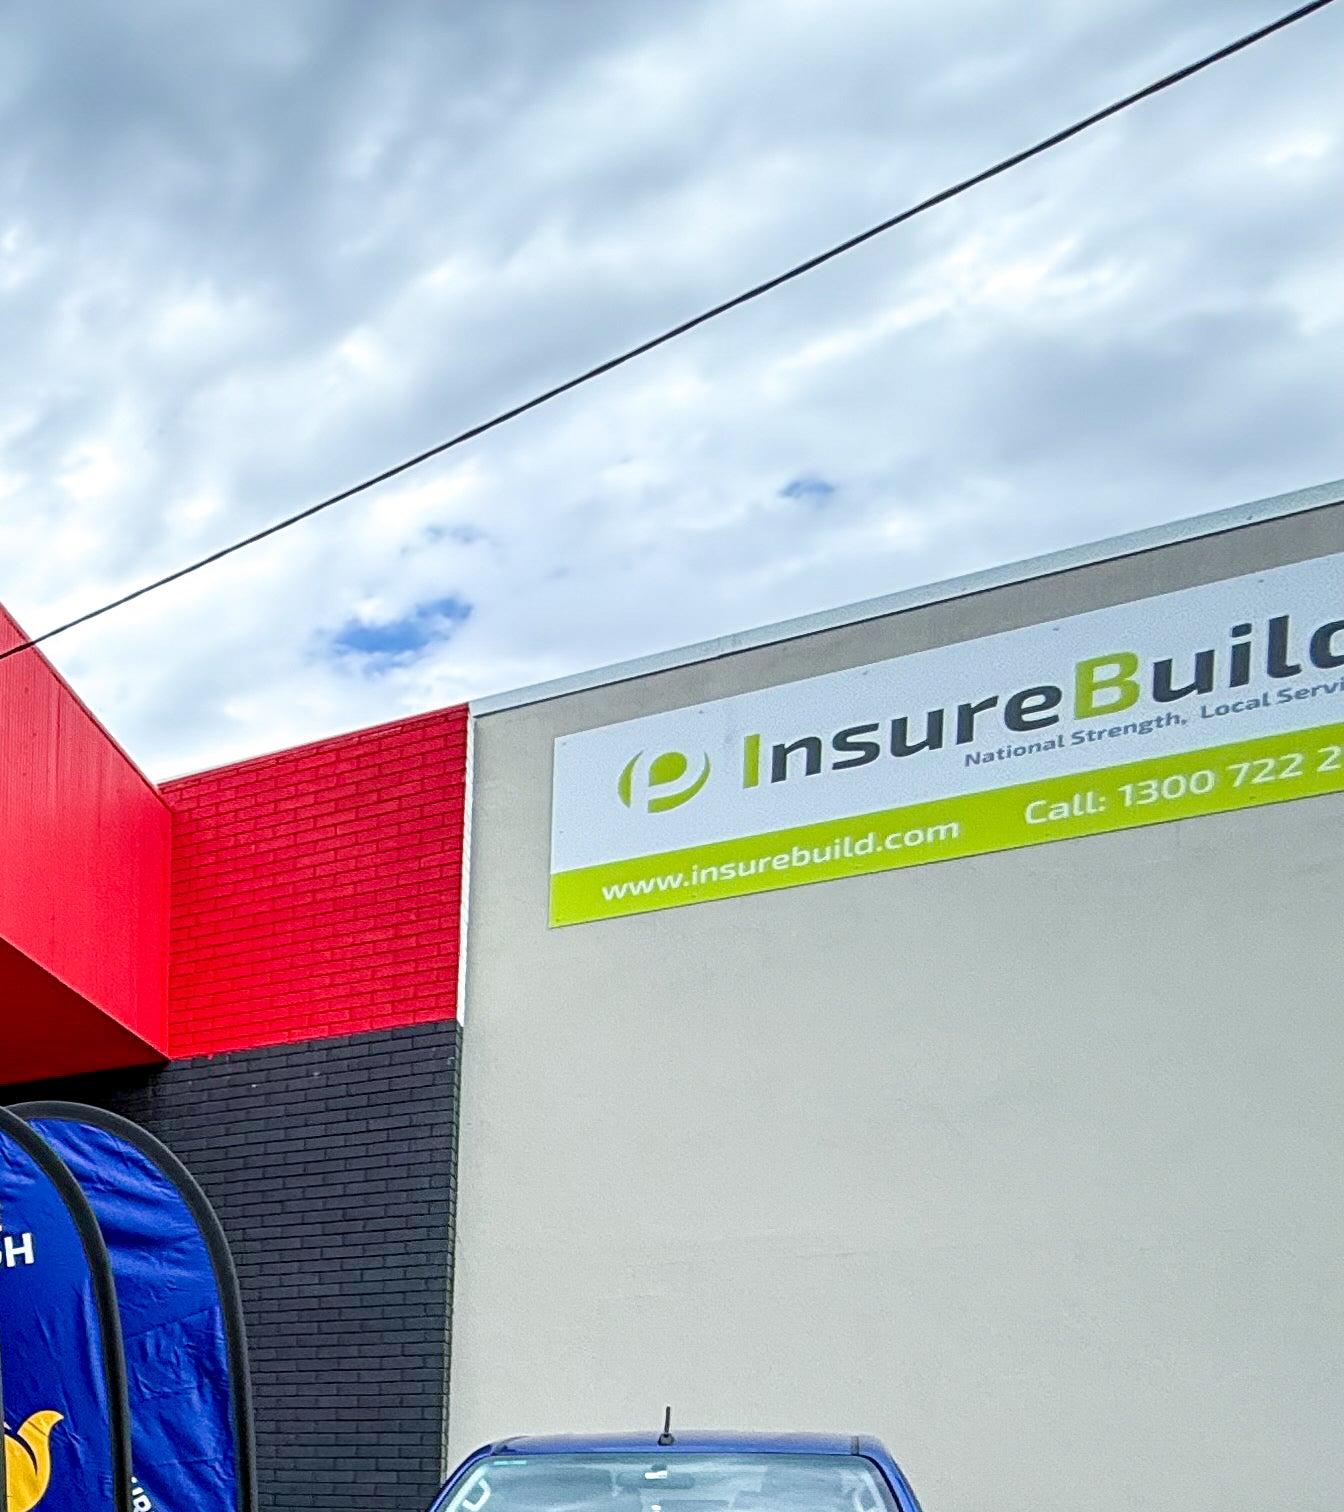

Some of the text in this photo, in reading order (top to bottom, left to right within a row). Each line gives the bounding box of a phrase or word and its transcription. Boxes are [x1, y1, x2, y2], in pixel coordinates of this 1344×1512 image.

[964, 733, 1065, 768] National
[1071, 713, 1188, 746] Strength,
[1200, 693, 1269, 720] Local
[1024, 790, 1106, 825] Call:
[1118, 770, 1216, 808] 1300
[1227, 753, 1303, 788] 722
[602, 819, 961, 902] www.insurebuild.com
